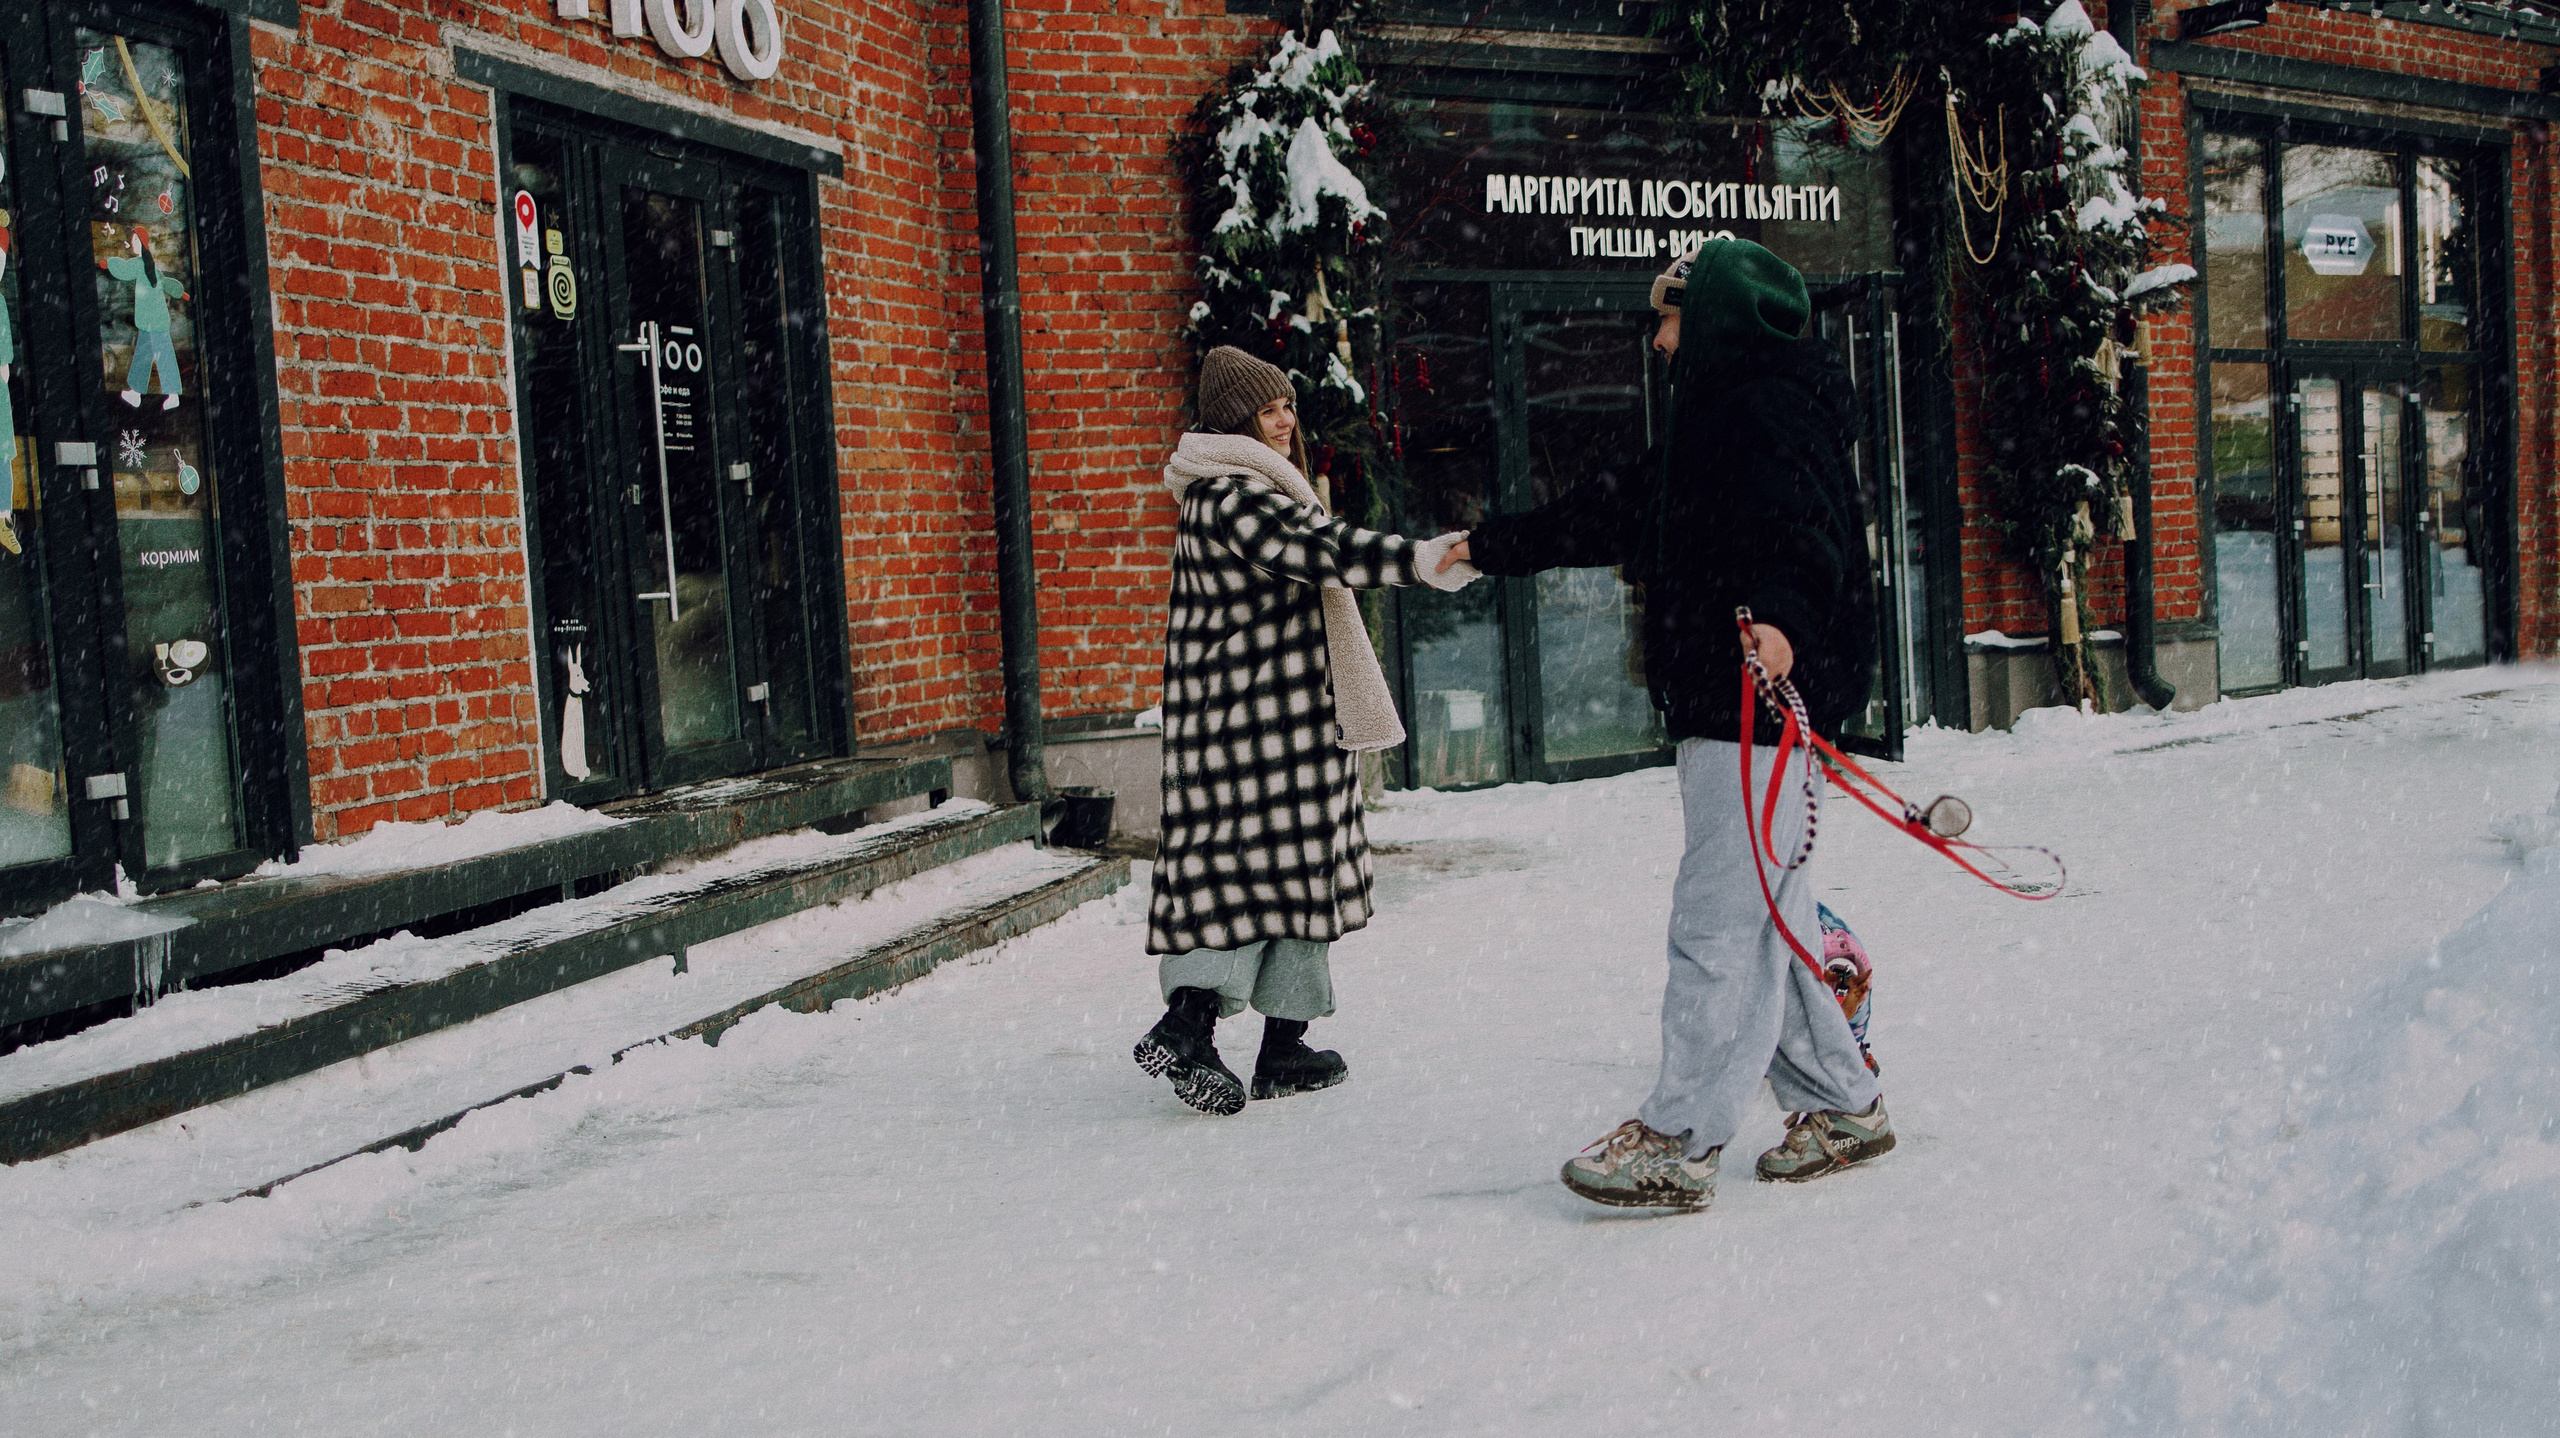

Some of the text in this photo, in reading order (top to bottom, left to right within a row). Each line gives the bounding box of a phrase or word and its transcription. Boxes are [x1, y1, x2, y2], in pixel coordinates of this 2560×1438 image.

[1486, 174, 1841, 221] МАРГАРИТА ЛЮБИТ КЬЯНТИ
[141, 549, 200, 570] кормим
[554, 625, 587, 633] dog-friendly
